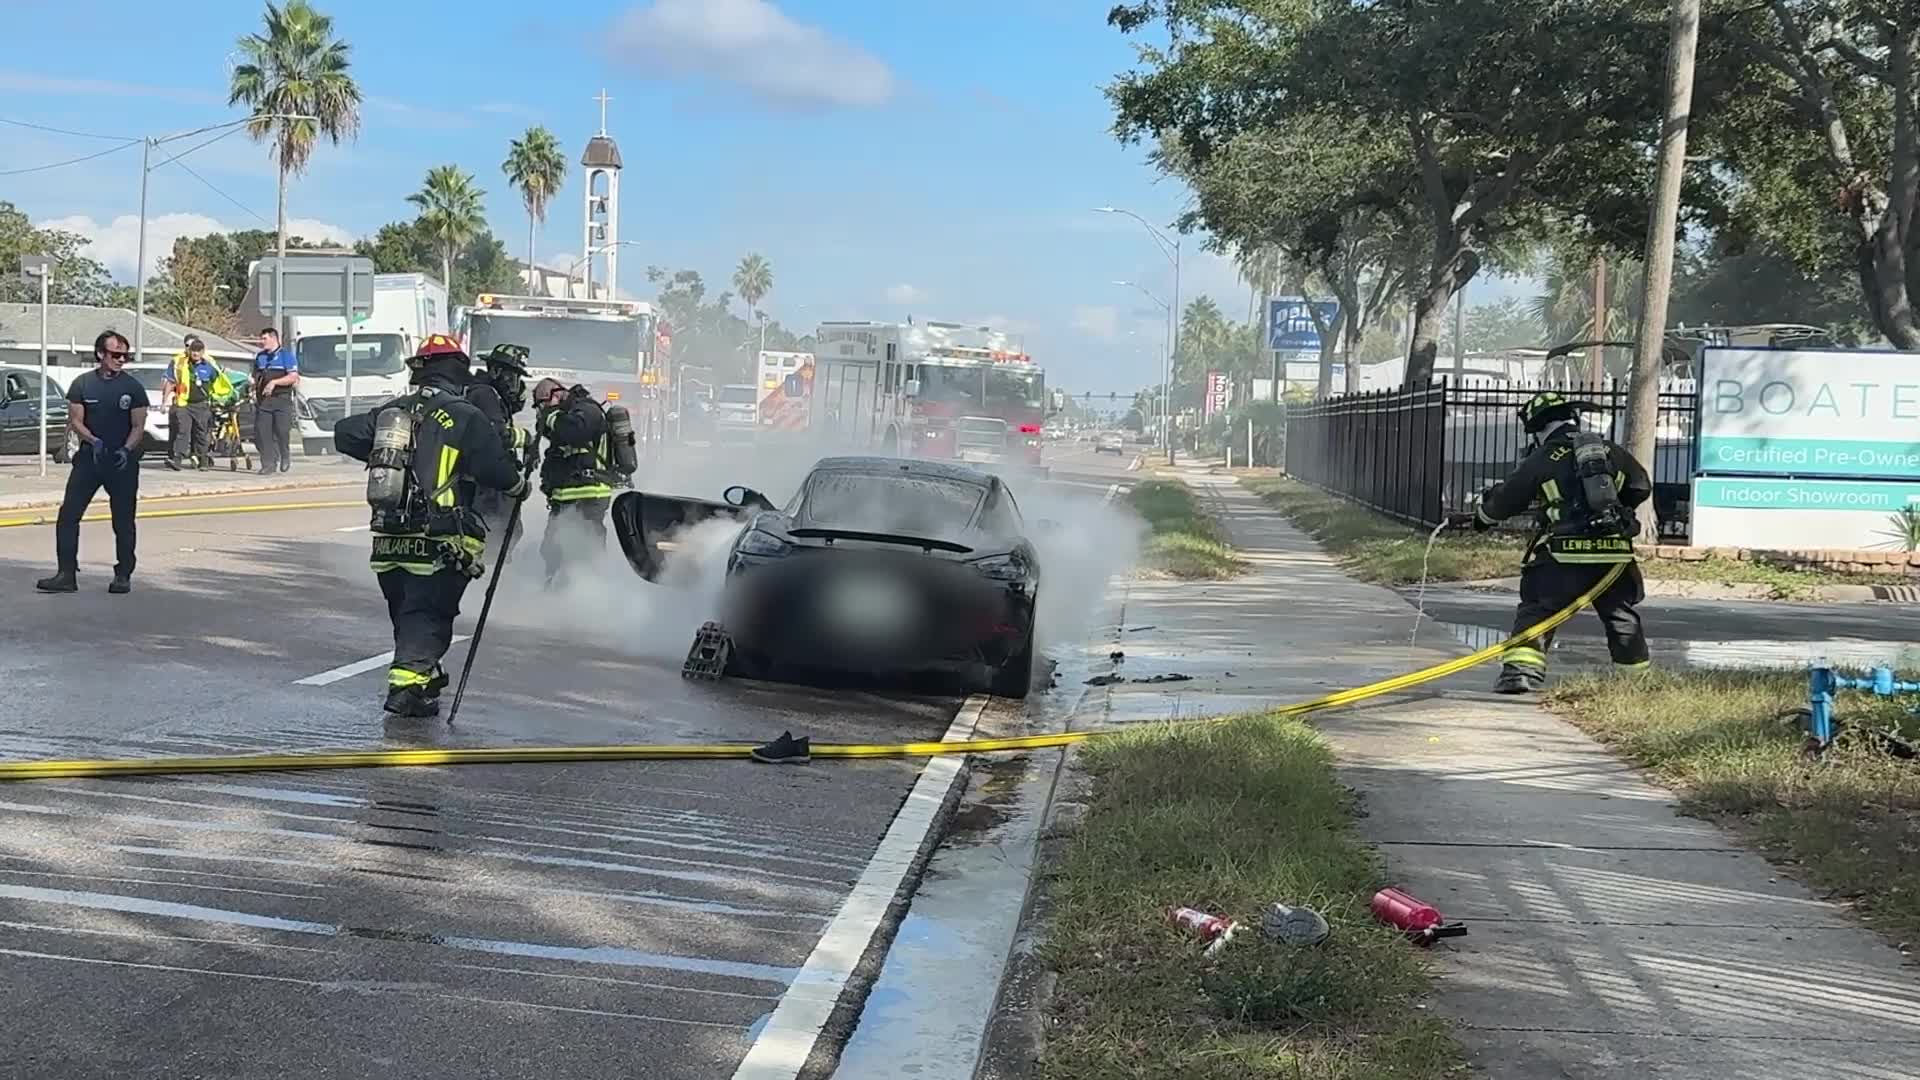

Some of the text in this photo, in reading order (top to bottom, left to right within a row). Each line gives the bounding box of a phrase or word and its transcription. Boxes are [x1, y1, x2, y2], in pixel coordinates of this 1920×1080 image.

[1715, 380, 1919, 418] BOATE
[1550, 446, 1572, 461] CLE
[1718, 445, 1920, 466] Certified Pre-Owne
[1721, 486, 1889, 505] Indoor Showroom
